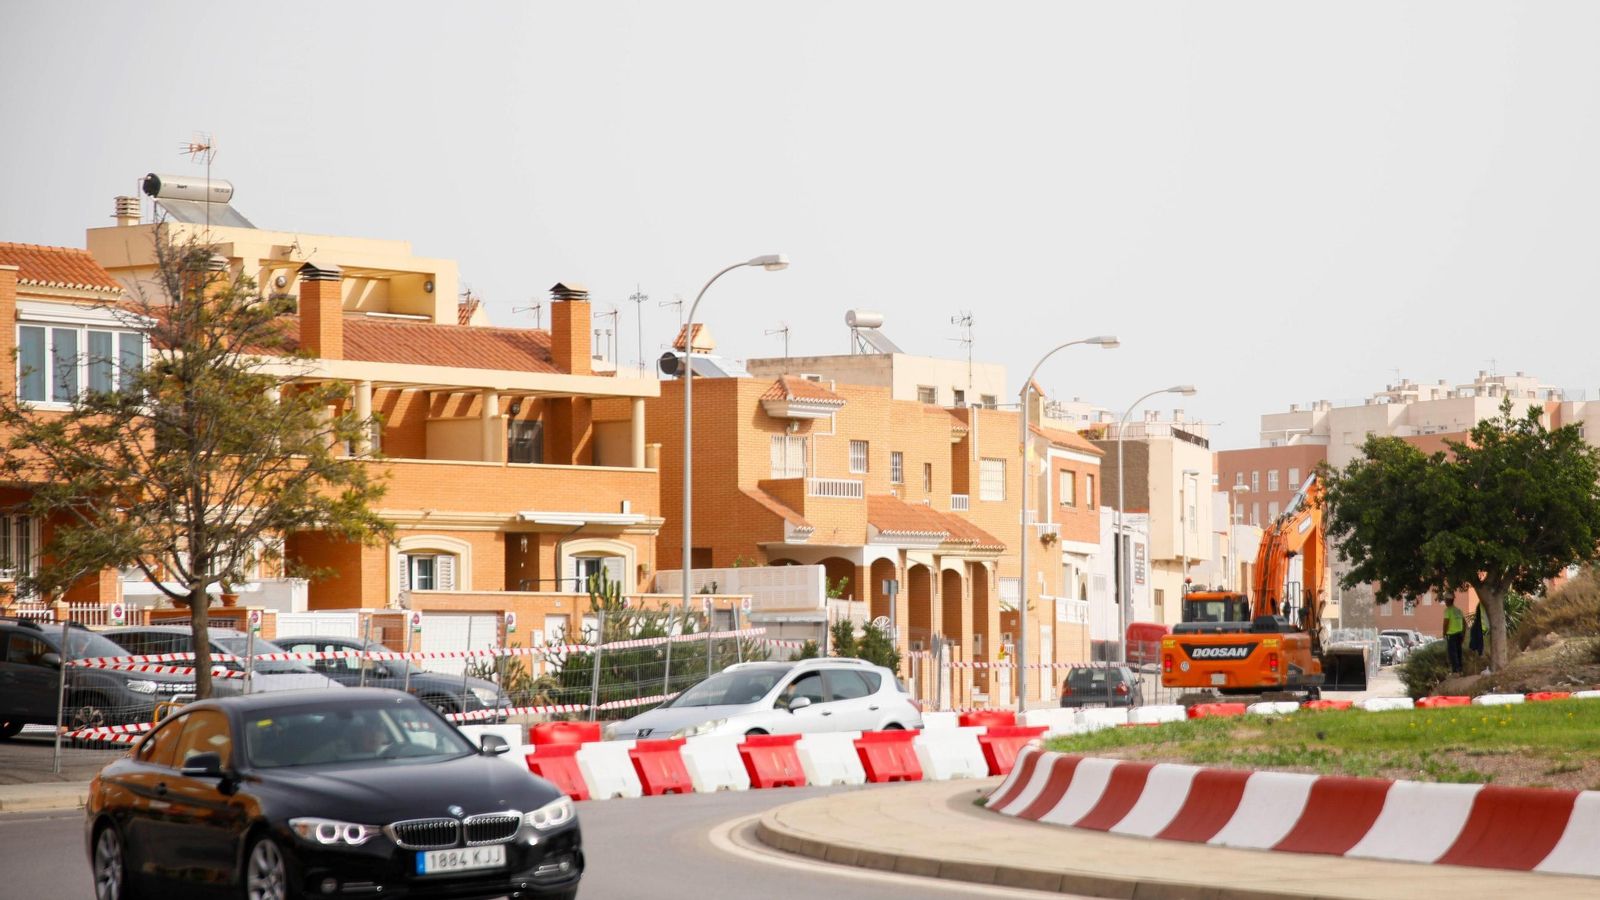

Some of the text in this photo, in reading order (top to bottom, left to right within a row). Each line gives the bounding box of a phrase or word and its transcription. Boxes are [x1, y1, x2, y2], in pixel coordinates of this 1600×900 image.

[1192, 647, 1247, 657] DOOSAN
[431, 849, 501, 869] 1884 KJJ
